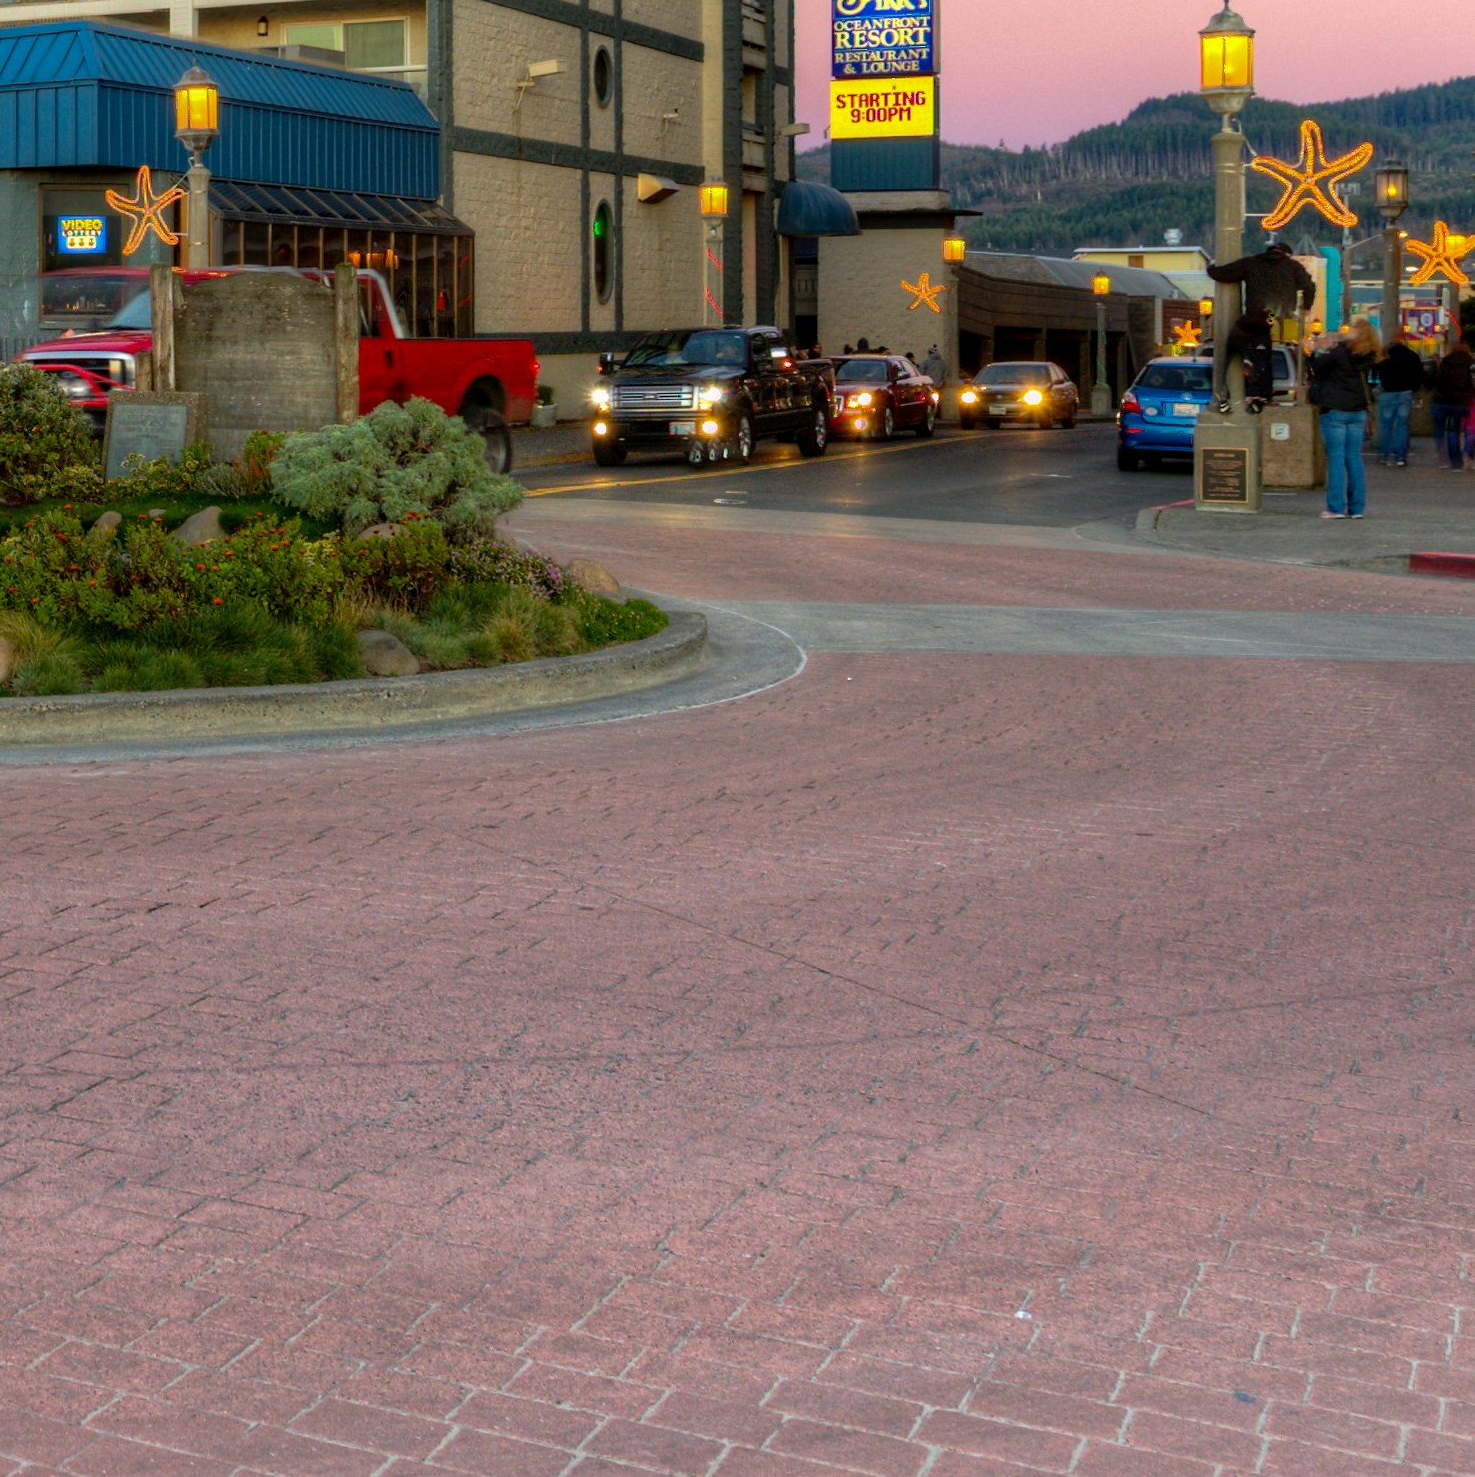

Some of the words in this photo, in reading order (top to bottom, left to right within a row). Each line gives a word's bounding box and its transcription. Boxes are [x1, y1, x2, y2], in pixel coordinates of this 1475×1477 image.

[834, 16, 931, 31] OCEANFRONT
[834, 27, 931, 49] RESORT
[834, 48, 930, 63] RESTAURANT
[844, 63, 857, 74] &
[862, 60, 920, 73] LOUNGE
[836, 90, 926, 109] STARTING
[850, 107, 911, 123] 9:00PM
[62, 229, 101, 237] LOTTERY
